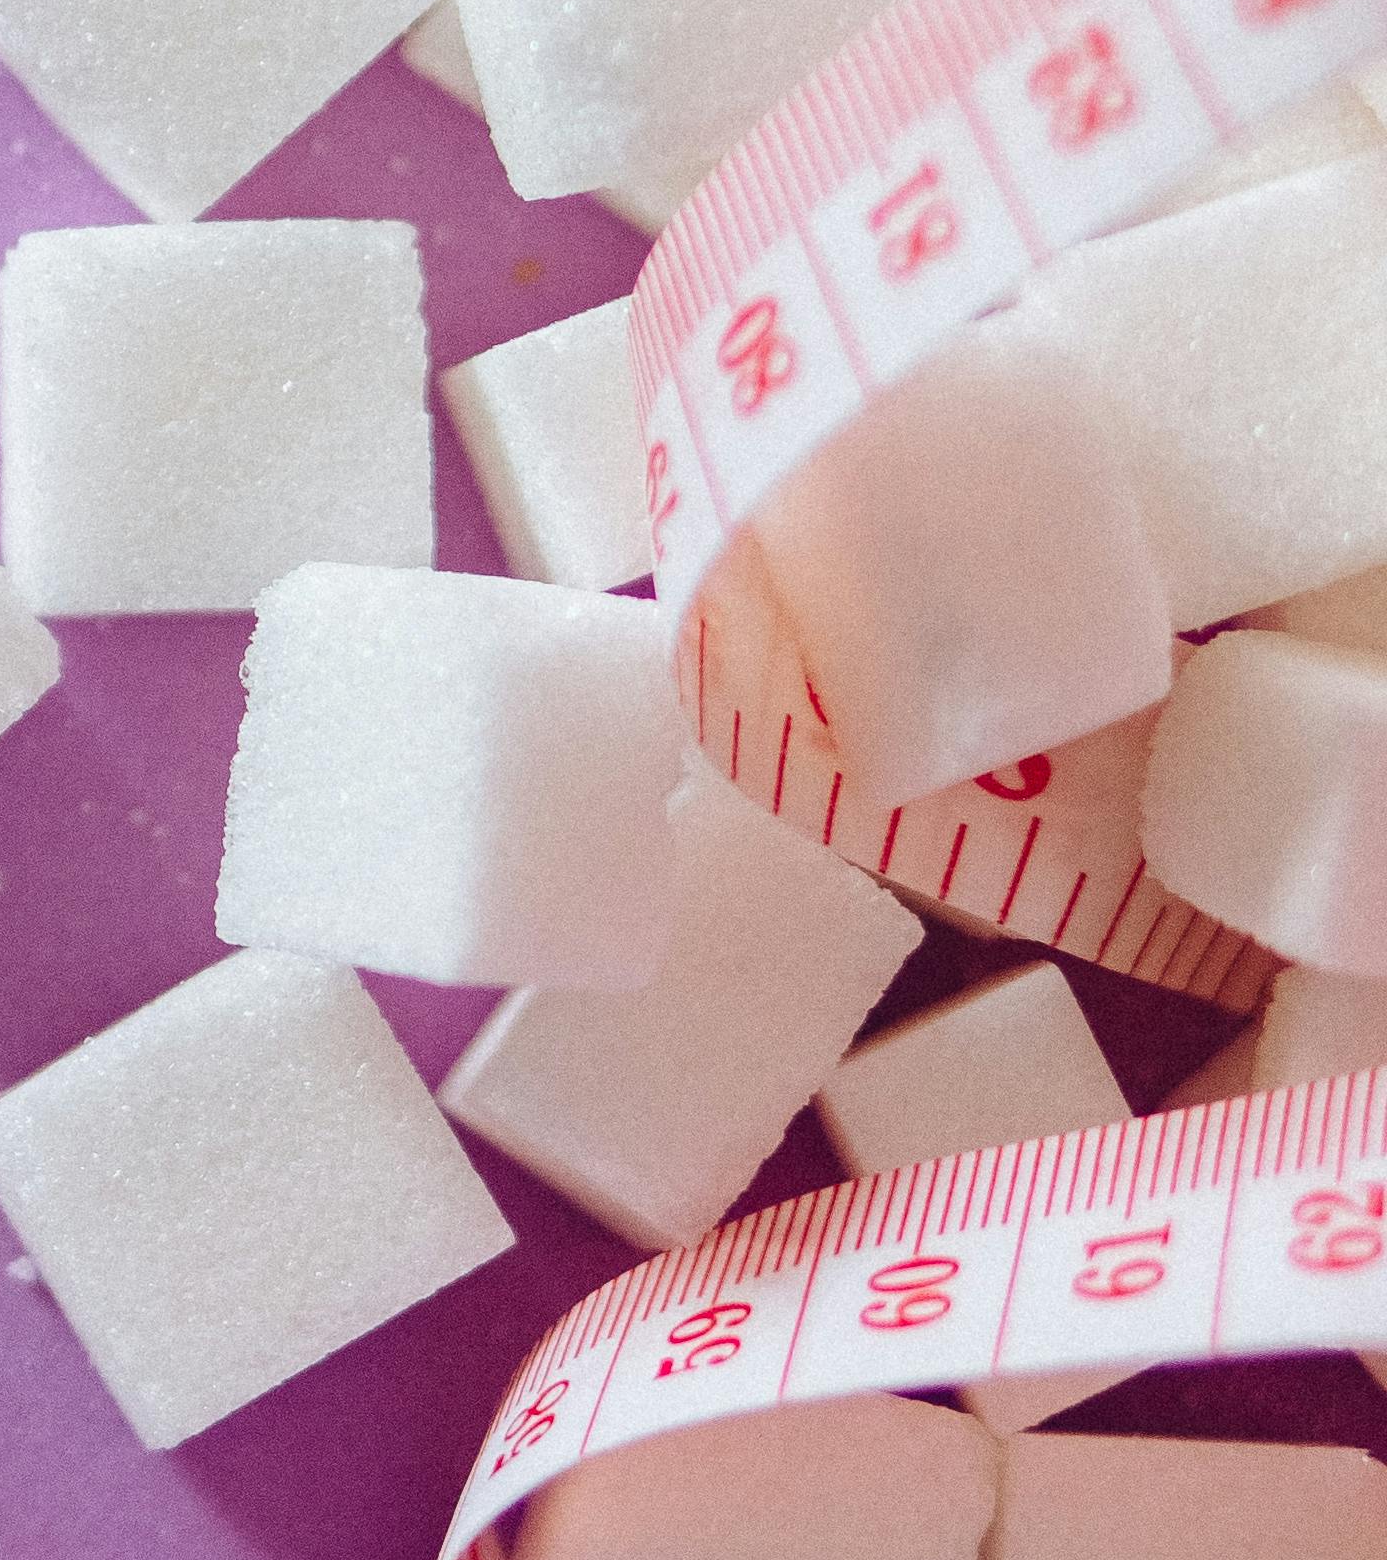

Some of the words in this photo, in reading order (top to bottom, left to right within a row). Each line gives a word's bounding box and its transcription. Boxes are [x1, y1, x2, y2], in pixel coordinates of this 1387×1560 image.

[867, 161, 963, 284] 81
[719, 296, 797, 415] 80
[1075, 1218, 1172, 1302] 61
[1285, 1180, 1387, 1271] 62
[860, 1255, 962, 1333] 60
[654, 1299, 753, 1381] 59
[487, 1378, 570, 1480] 58
